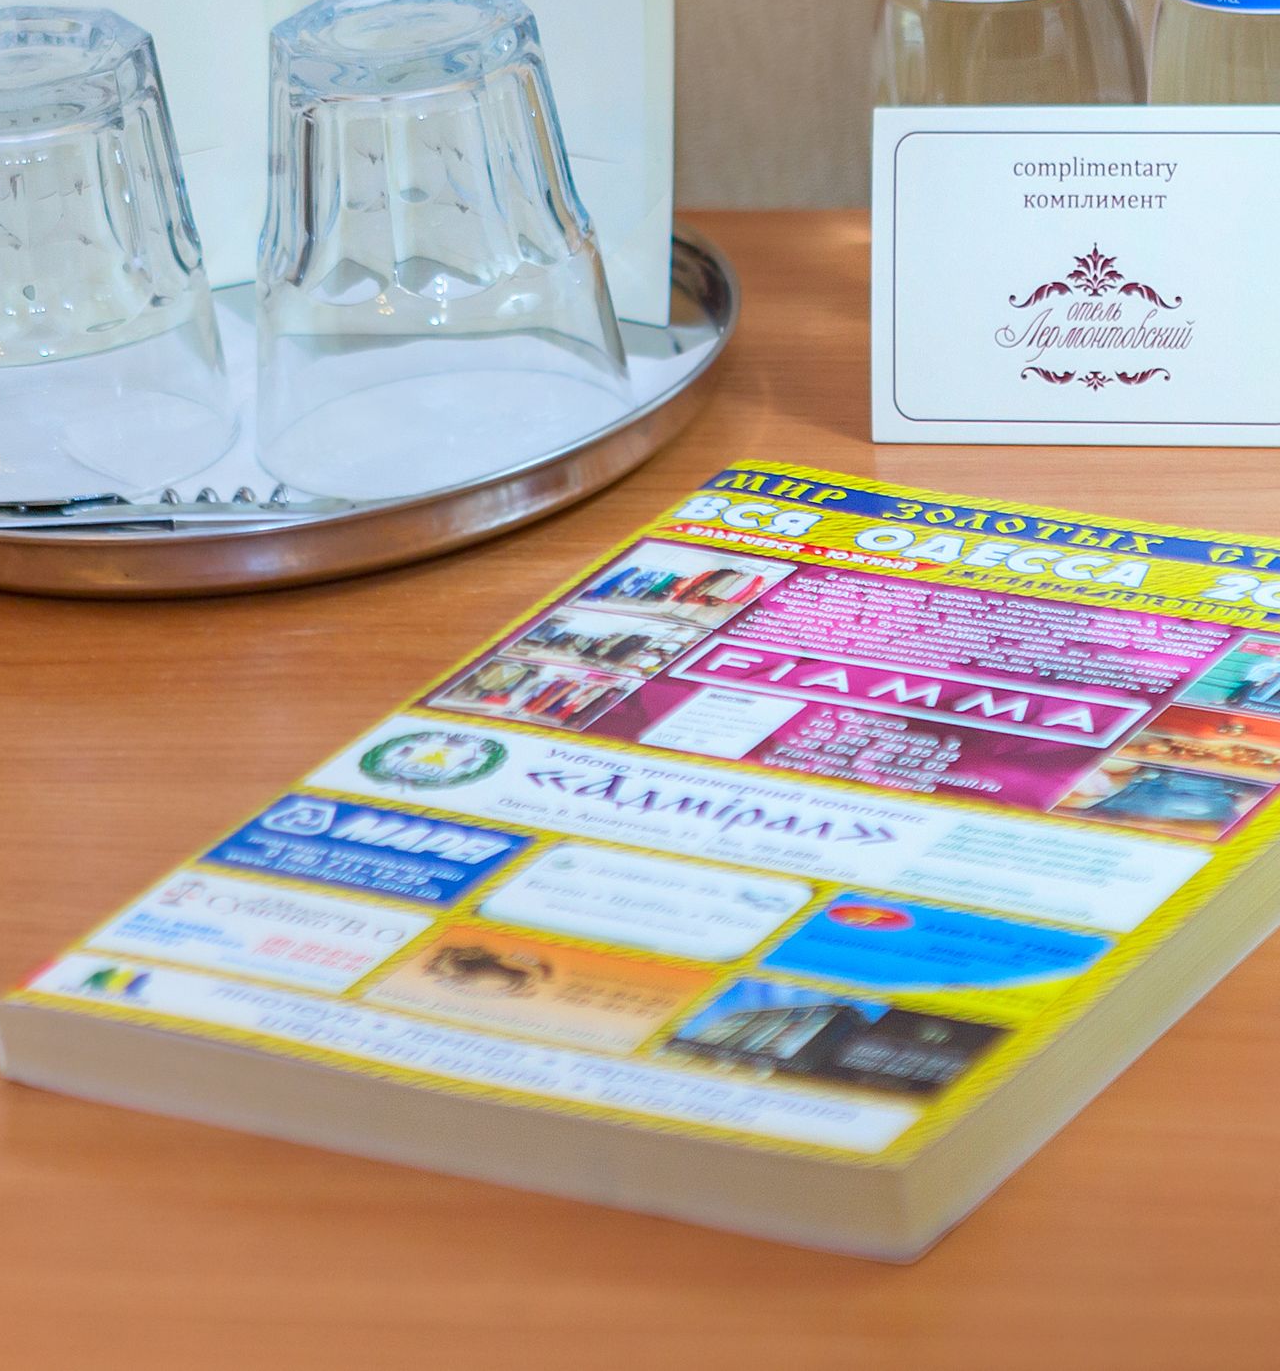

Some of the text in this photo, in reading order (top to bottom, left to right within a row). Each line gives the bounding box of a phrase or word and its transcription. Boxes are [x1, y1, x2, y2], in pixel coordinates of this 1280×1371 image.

[1013, 157, 1178, 182] complimentary
[1024, 194, 1167, 209] комплимент
[1067, 301, 1122, 322] отель
[995, 308, 1195, 363] Лермонтовский
[715, 473, 848, 506] МИР
[881, 501, 1165, 555] ЗОЛОТЫХ
[673, 496, 824, 537] ВСЯ
[856, 526, 1151, 589] ОДЕССА
[686, 526, 920, 572] ИЛЬИЧЕВСК ЮЖНЫЙ
[705, 652, 1096, 735] FIAMMA
[834, 712, 912, 731] Одесса
[810, 795, 930, 825] комплекс
[329, 815, 512, 865] MAPEI
